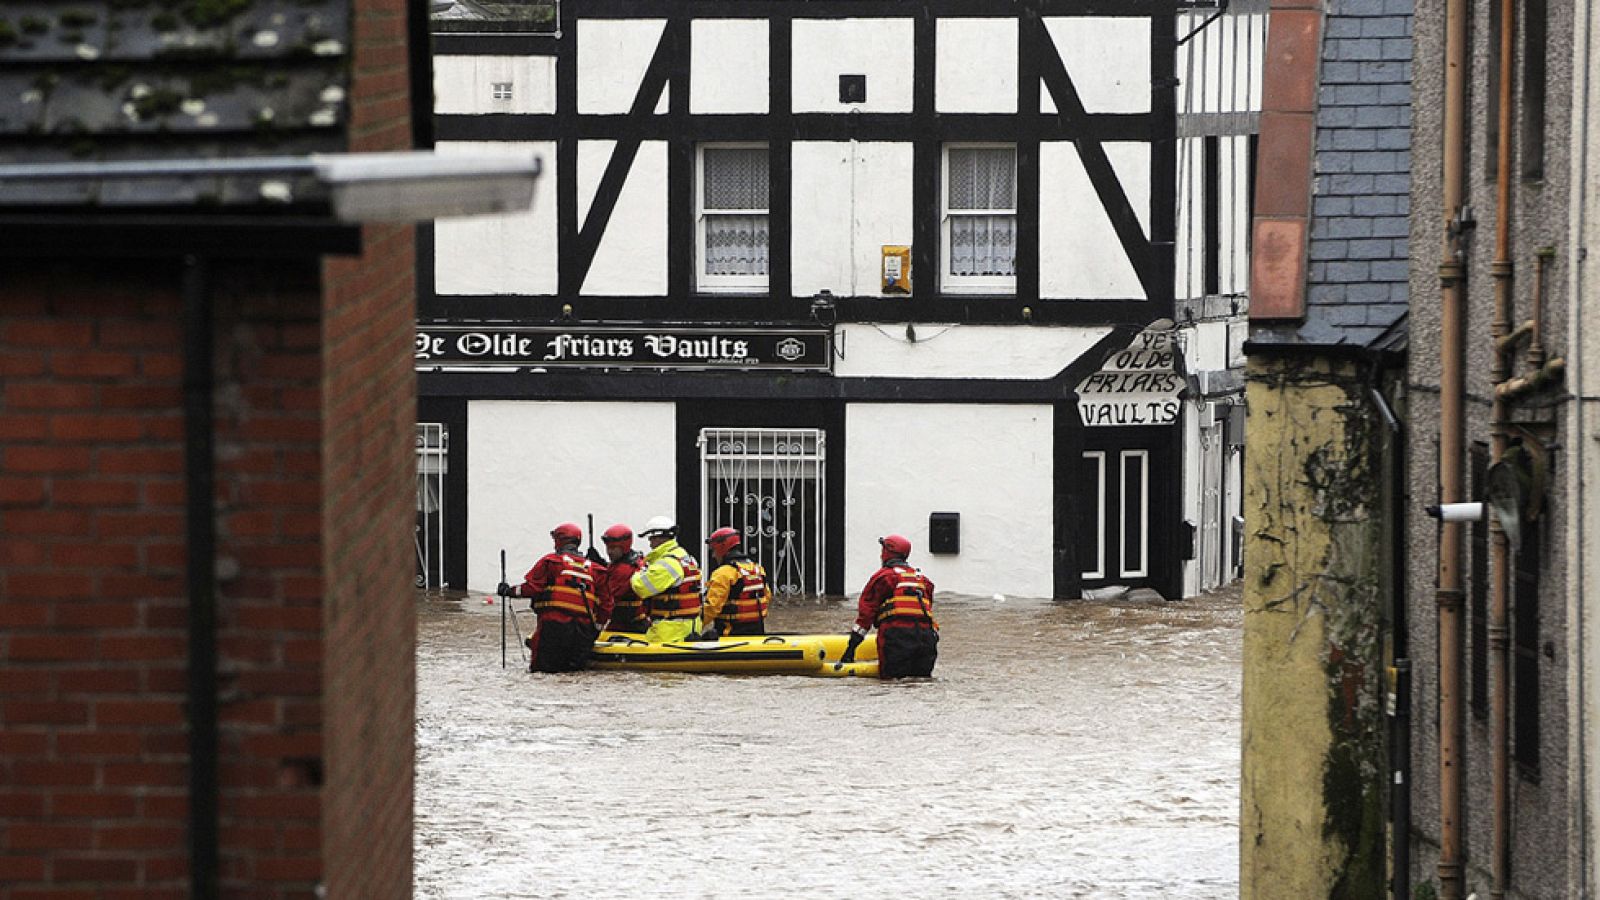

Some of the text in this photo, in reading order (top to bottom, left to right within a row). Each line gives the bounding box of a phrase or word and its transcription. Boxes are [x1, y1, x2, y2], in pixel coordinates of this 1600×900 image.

[457, 332, 532, 356] Olde
[544, 334, 633, 360] Friars
[644, 334, 749, 358] Vaults
[1083, 374, 1178, 393] FRIARS
[1082, 403, 1177, 424] VAULTS
